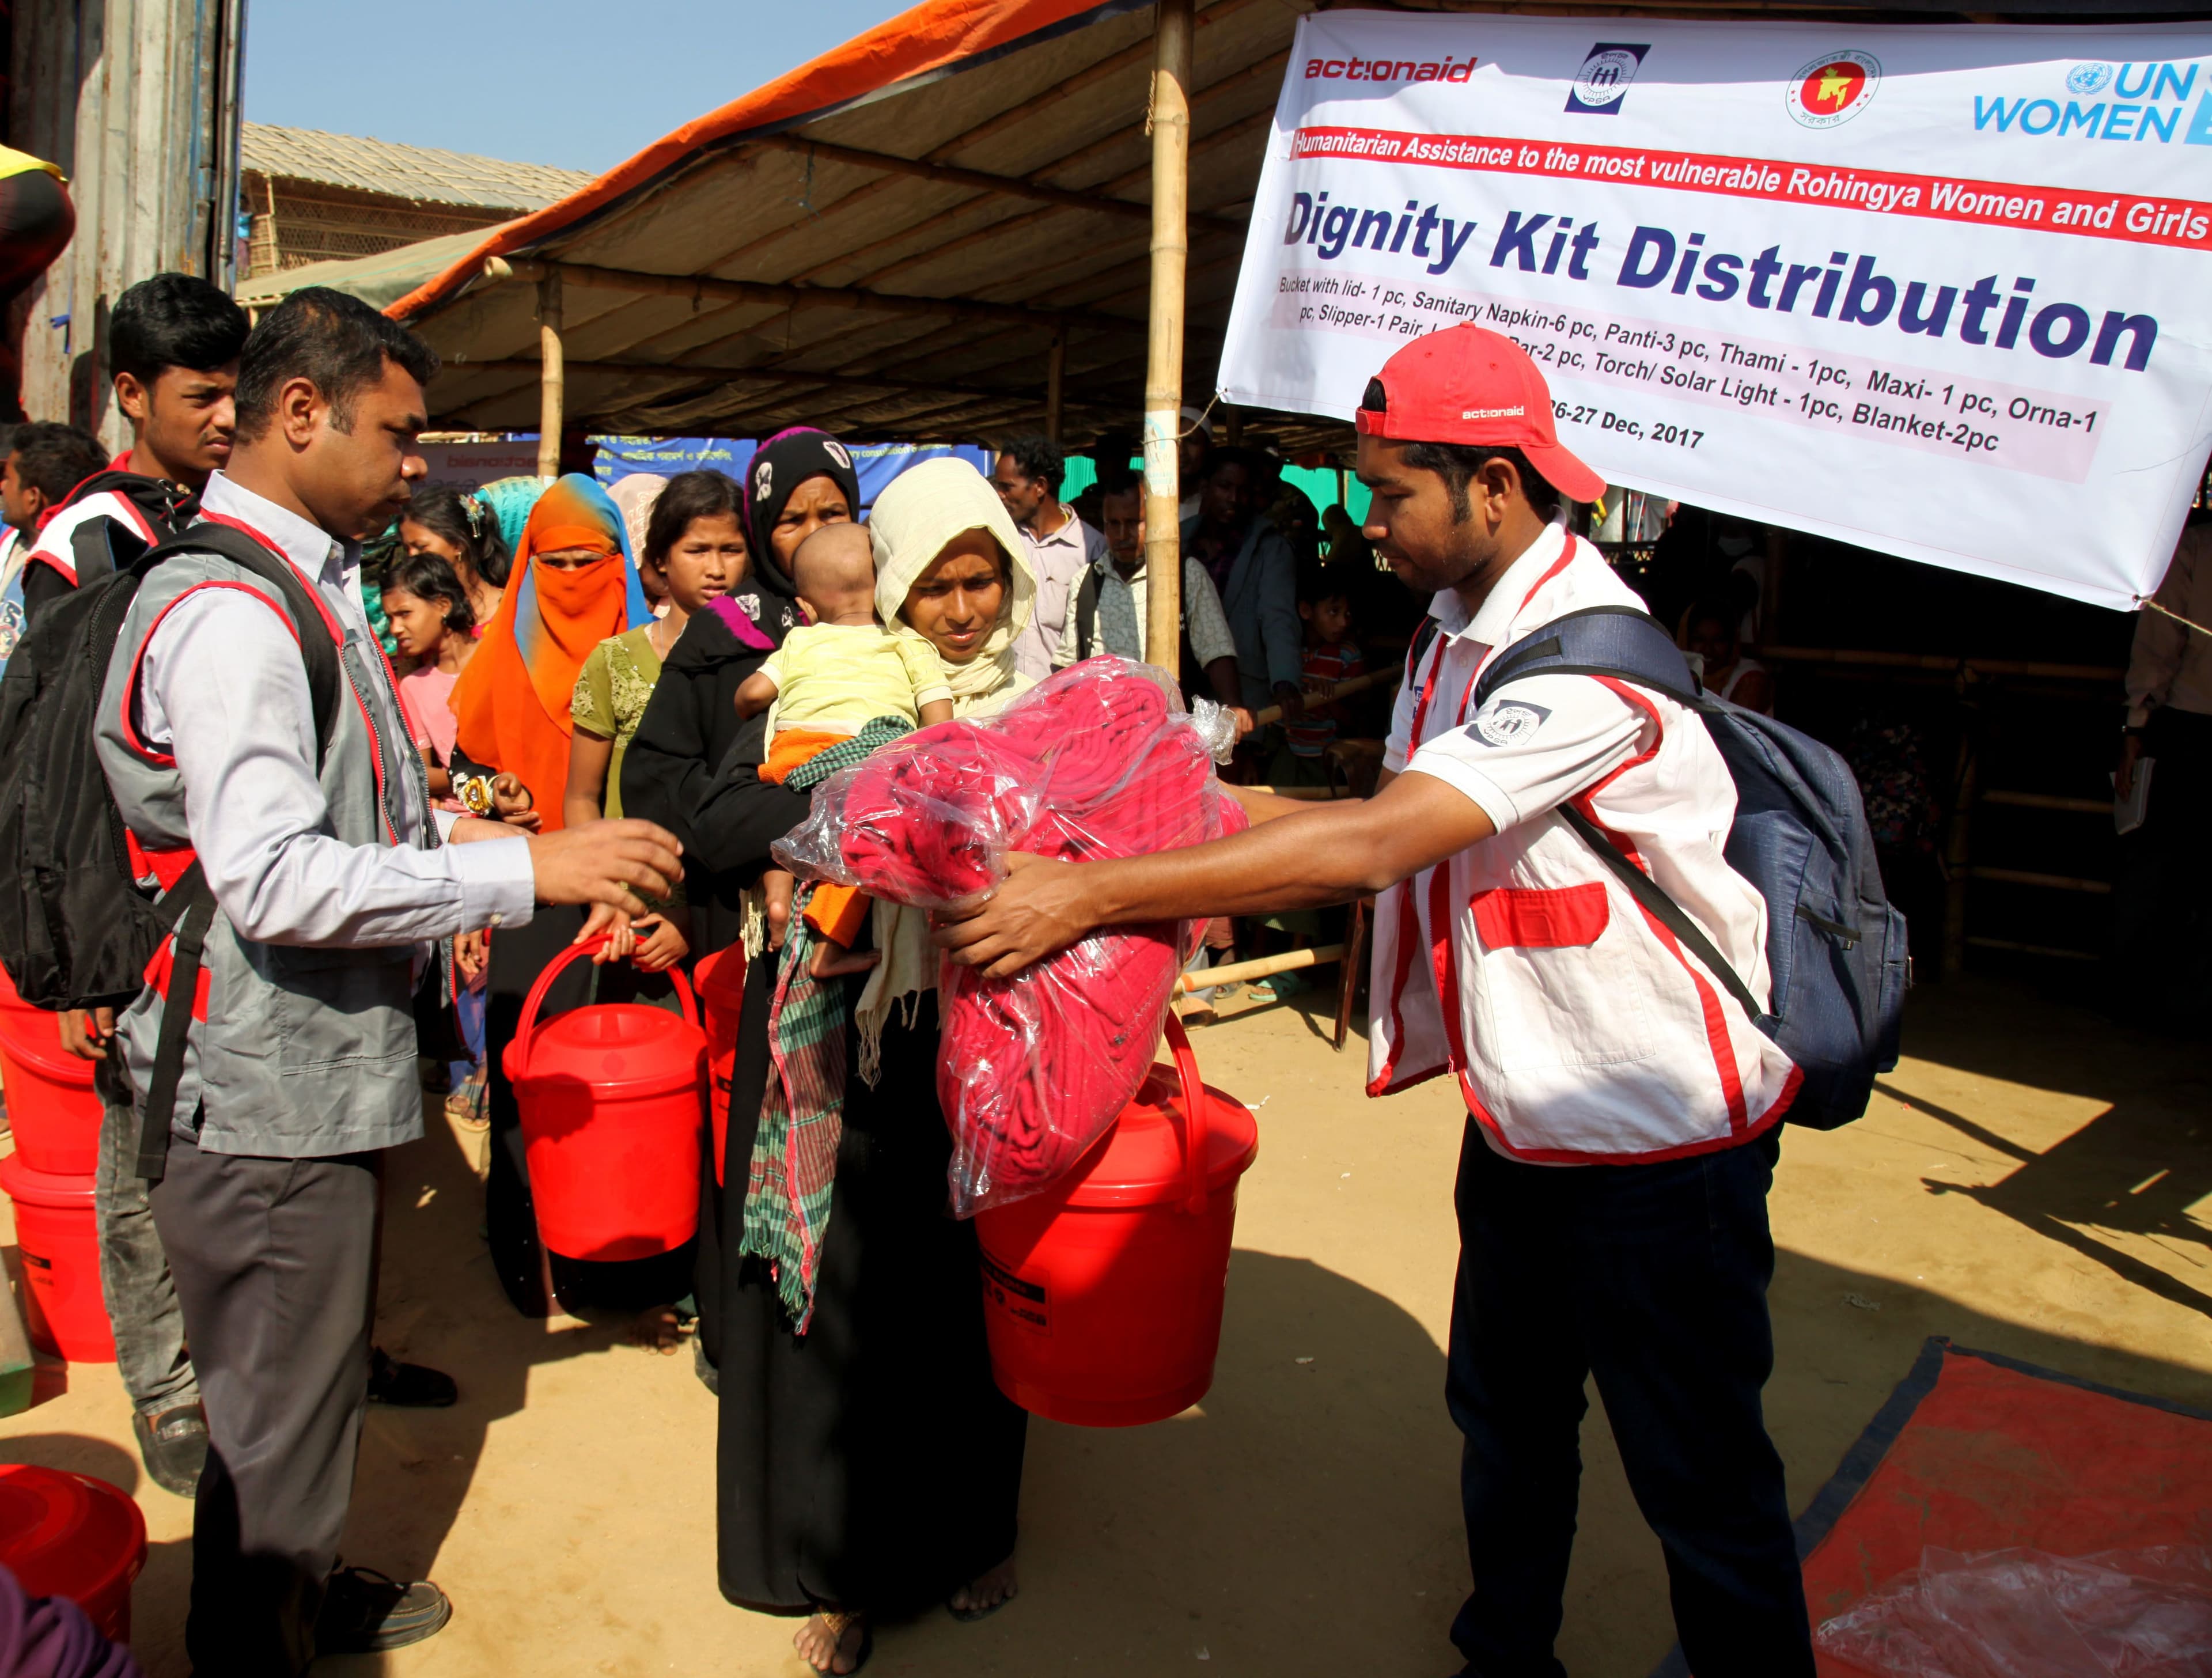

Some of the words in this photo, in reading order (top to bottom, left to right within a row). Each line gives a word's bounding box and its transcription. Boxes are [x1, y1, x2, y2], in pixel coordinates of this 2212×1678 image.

[1582, 94, 1611, 104] YPSA
[2114, 63, 2200, 101] UN
[1974, 95, 2183, 144] WOMEN
[1294, 131, 1401, 156] Humanitarian
[1402, 137, 1513, 166] Assistance
[1517, 146, 1539, 168] to
[1544, 147, 1580, 172] the
[1584, 156, 1645, 178] most
[1651, 158, 1781, 192] vulnerable
[1786, 168, 1921, 212] Rohingya
[1930, 182, 2044, 221] Women
[2052, 200, 2119, 229] and
[2126, 202, 2209, 240] Girls
[1283, 191, 1478, 275] Dignity
[1489, 211, 1600, 281] Kit
[1616, 226, 2158, 372] Distribution
[1279, 276, 1311, 293] Bucket
[1312, 278, 1339, 294] with
[1342, 279, 1366, 297] lid-
[1373, 285, 1380, 300] 1
[1382, 290, 1407, 308] pc,
[1412, 291, 1483, 321] Sanitary
[1486, 302, 1567, 332] Napkin-6
[1569, 321, 1597, 342] pc,
[1604, 323, 1675, 352] Panti-3
[1678, 340, 1709, 362] pc,
[1721, 342, 1787, 373] Thami
[1809, 359, 1851, 389] 1pc,
[1866, 370, 1933, 400] Maxi-
[1943, 384, 1954, 406] 1
[1959, 393, 1997, 418] pc,
[2008, 397, 2097, 433] Orna-1
[1299, 306, 1315, 324] pc,
[1319, 304, 1385, 329] Slipper-1
[1557, 350, 1585, 370] pc,
[1660, 366, 1717, 392] Solar
[1720, 377, 1778, 406] Light
[1800, 392, 1843, 423] 1pc,
[1851, 402, 1999, 452] Blanket-2pc
[1601, 411, 1644, 441] Dec,
[1650, 423, 1705, 449] 2017
[1483, 729, 1508, 745] YPSA
